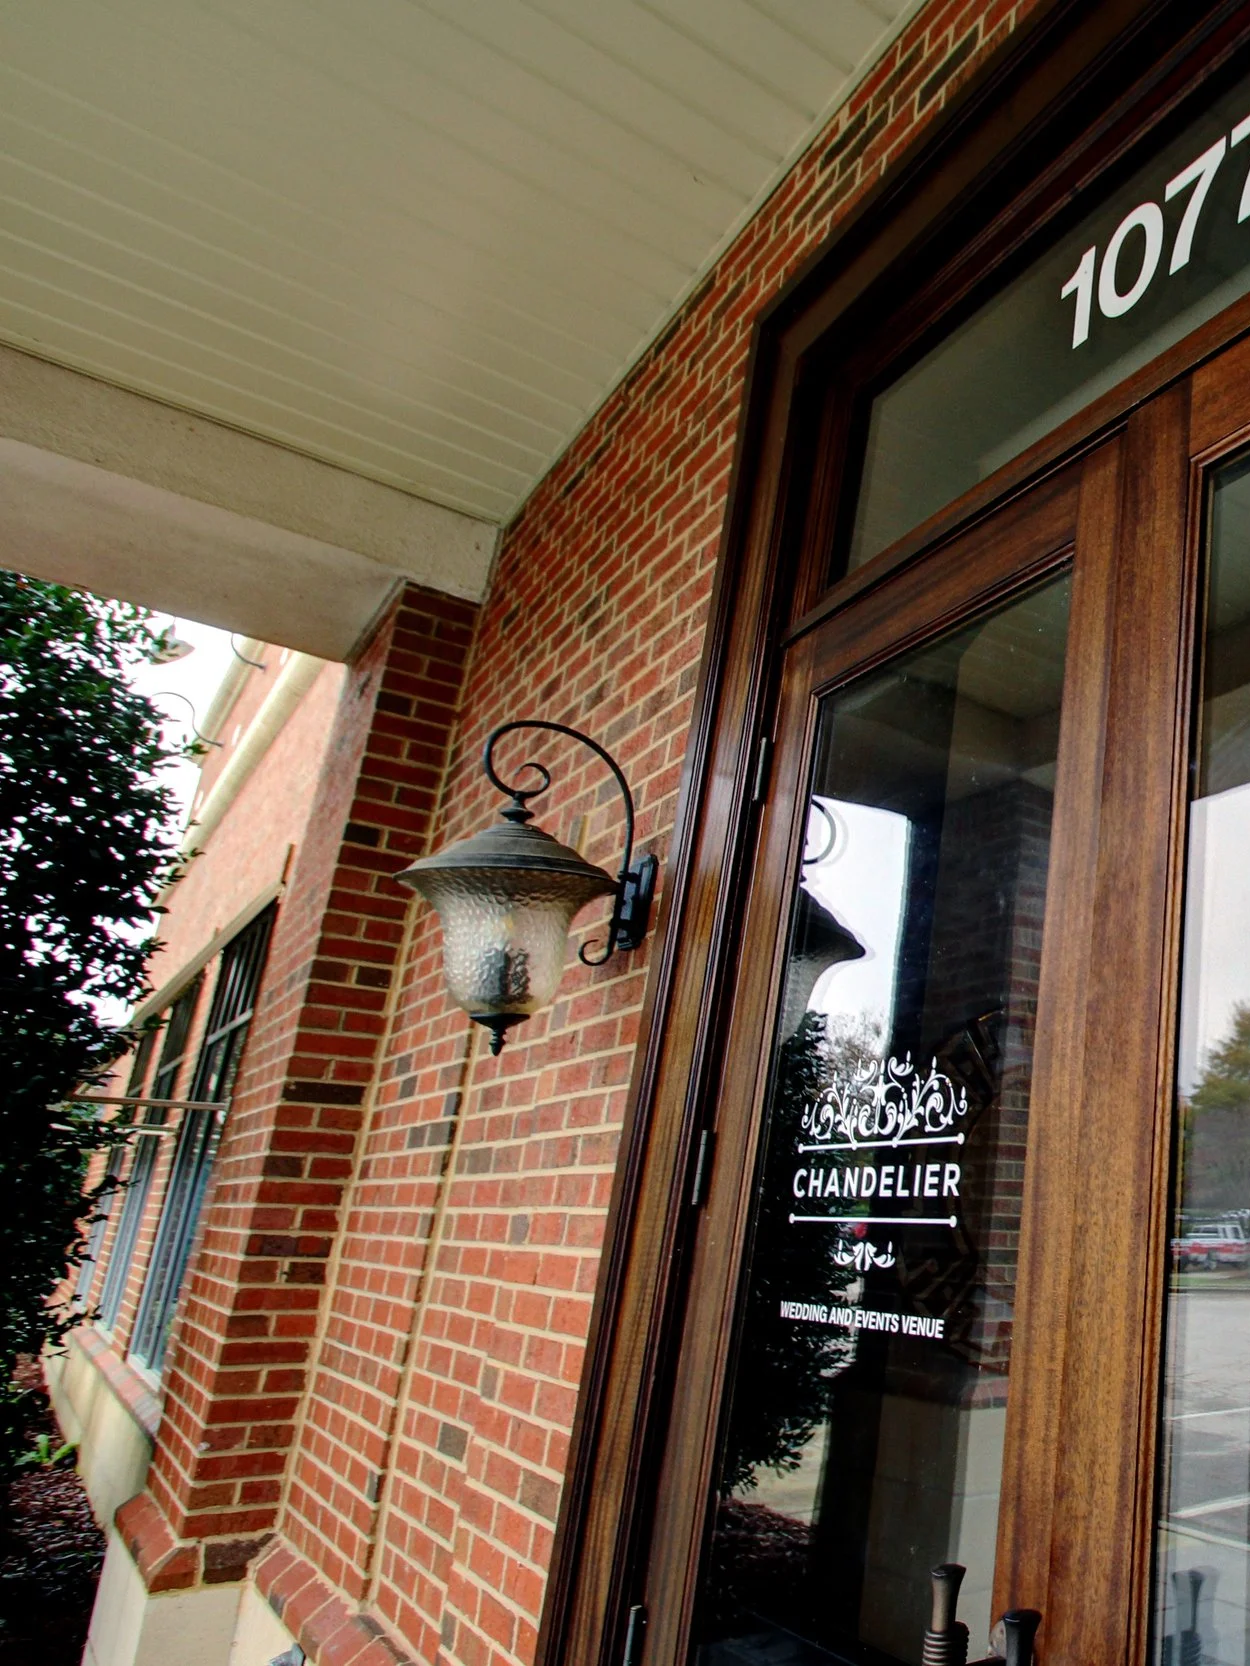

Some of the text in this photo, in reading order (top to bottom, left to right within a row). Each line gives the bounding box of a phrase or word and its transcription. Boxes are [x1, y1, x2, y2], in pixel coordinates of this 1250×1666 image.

[793, 1163, 961, 1198] CHANDELIER
[780, 1301, 944, 1338] WEDDING AND EVENTS VENUE
